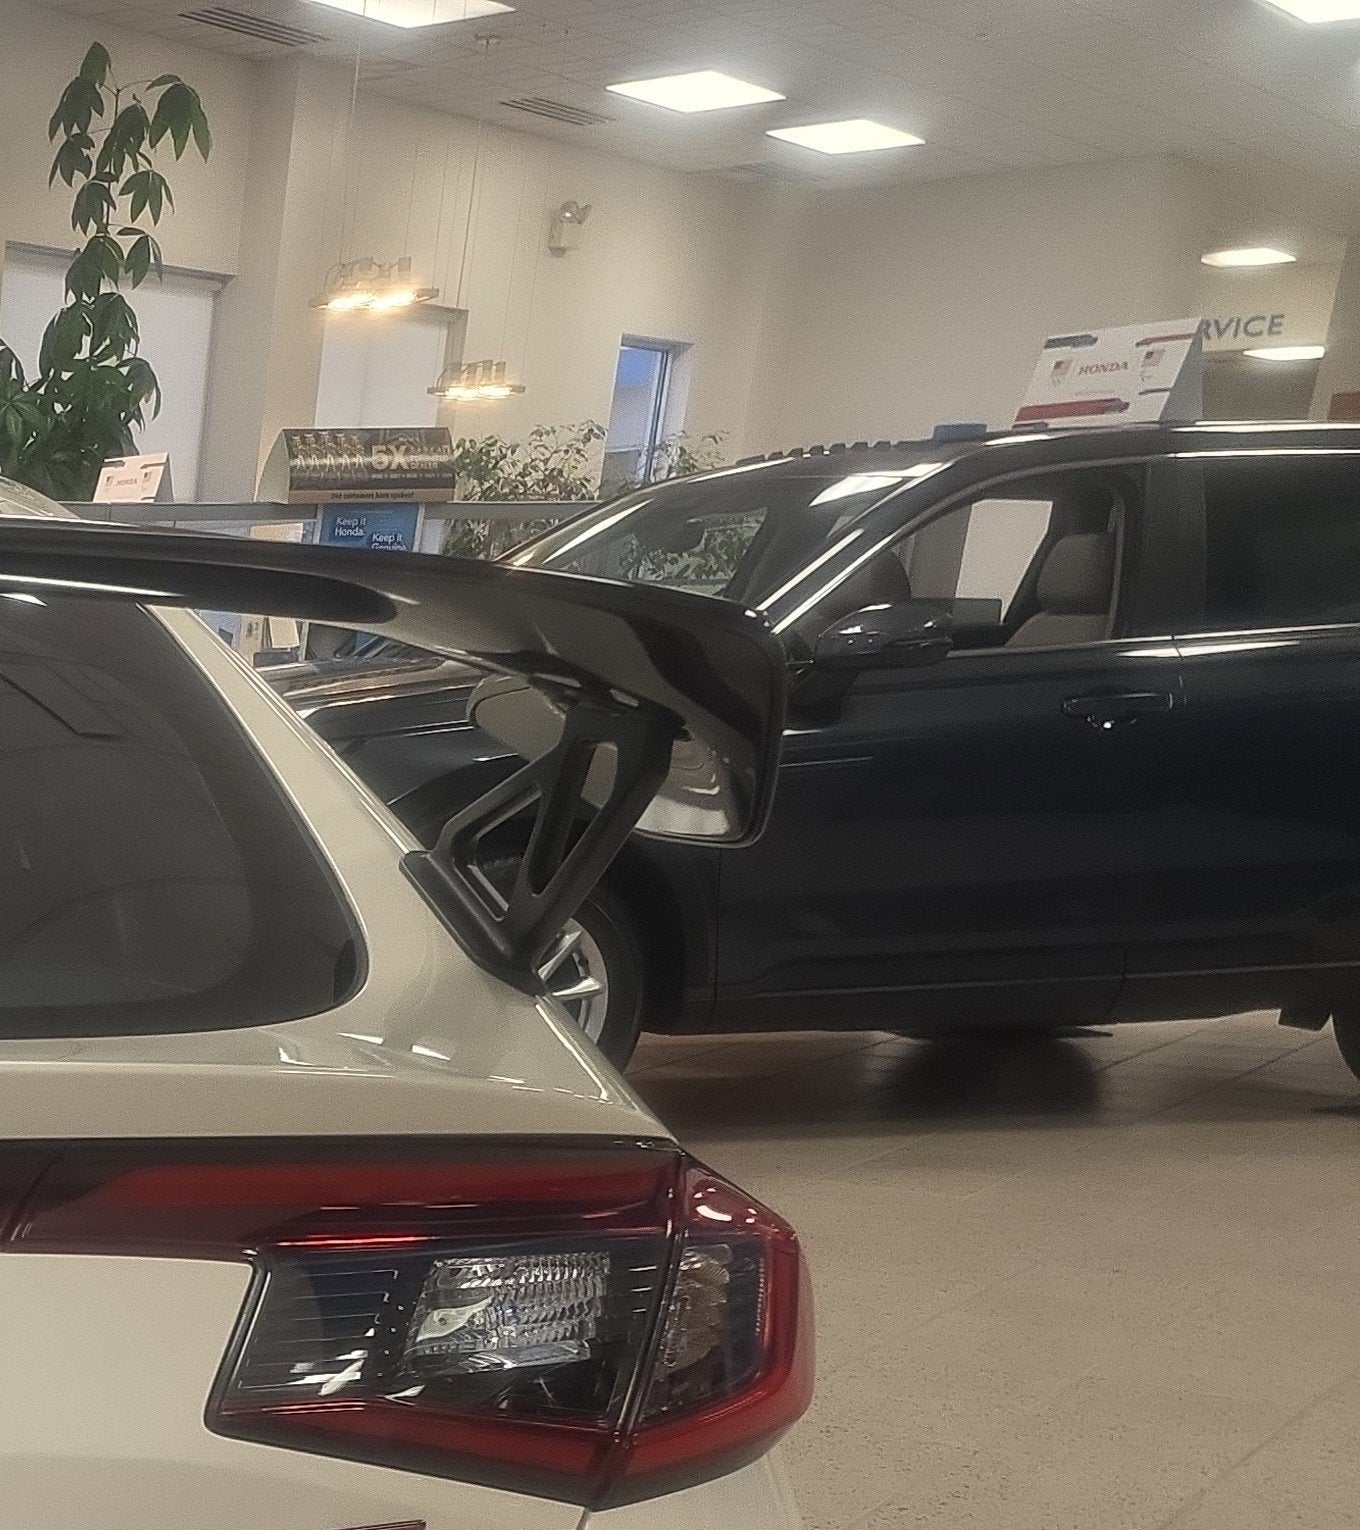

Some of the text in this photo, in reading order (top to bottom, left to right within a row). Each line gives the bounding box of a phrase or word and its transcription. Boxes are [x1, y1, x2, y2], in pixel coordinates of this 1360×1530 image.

[1078, 361, 1129, 376] HONDA
[372, 445, 409, 470] 5X
[336, 517, 367, 528] Keep it
[335, 527, 366, 537] Honda.
[372, 532, 403, 544] Keep it
